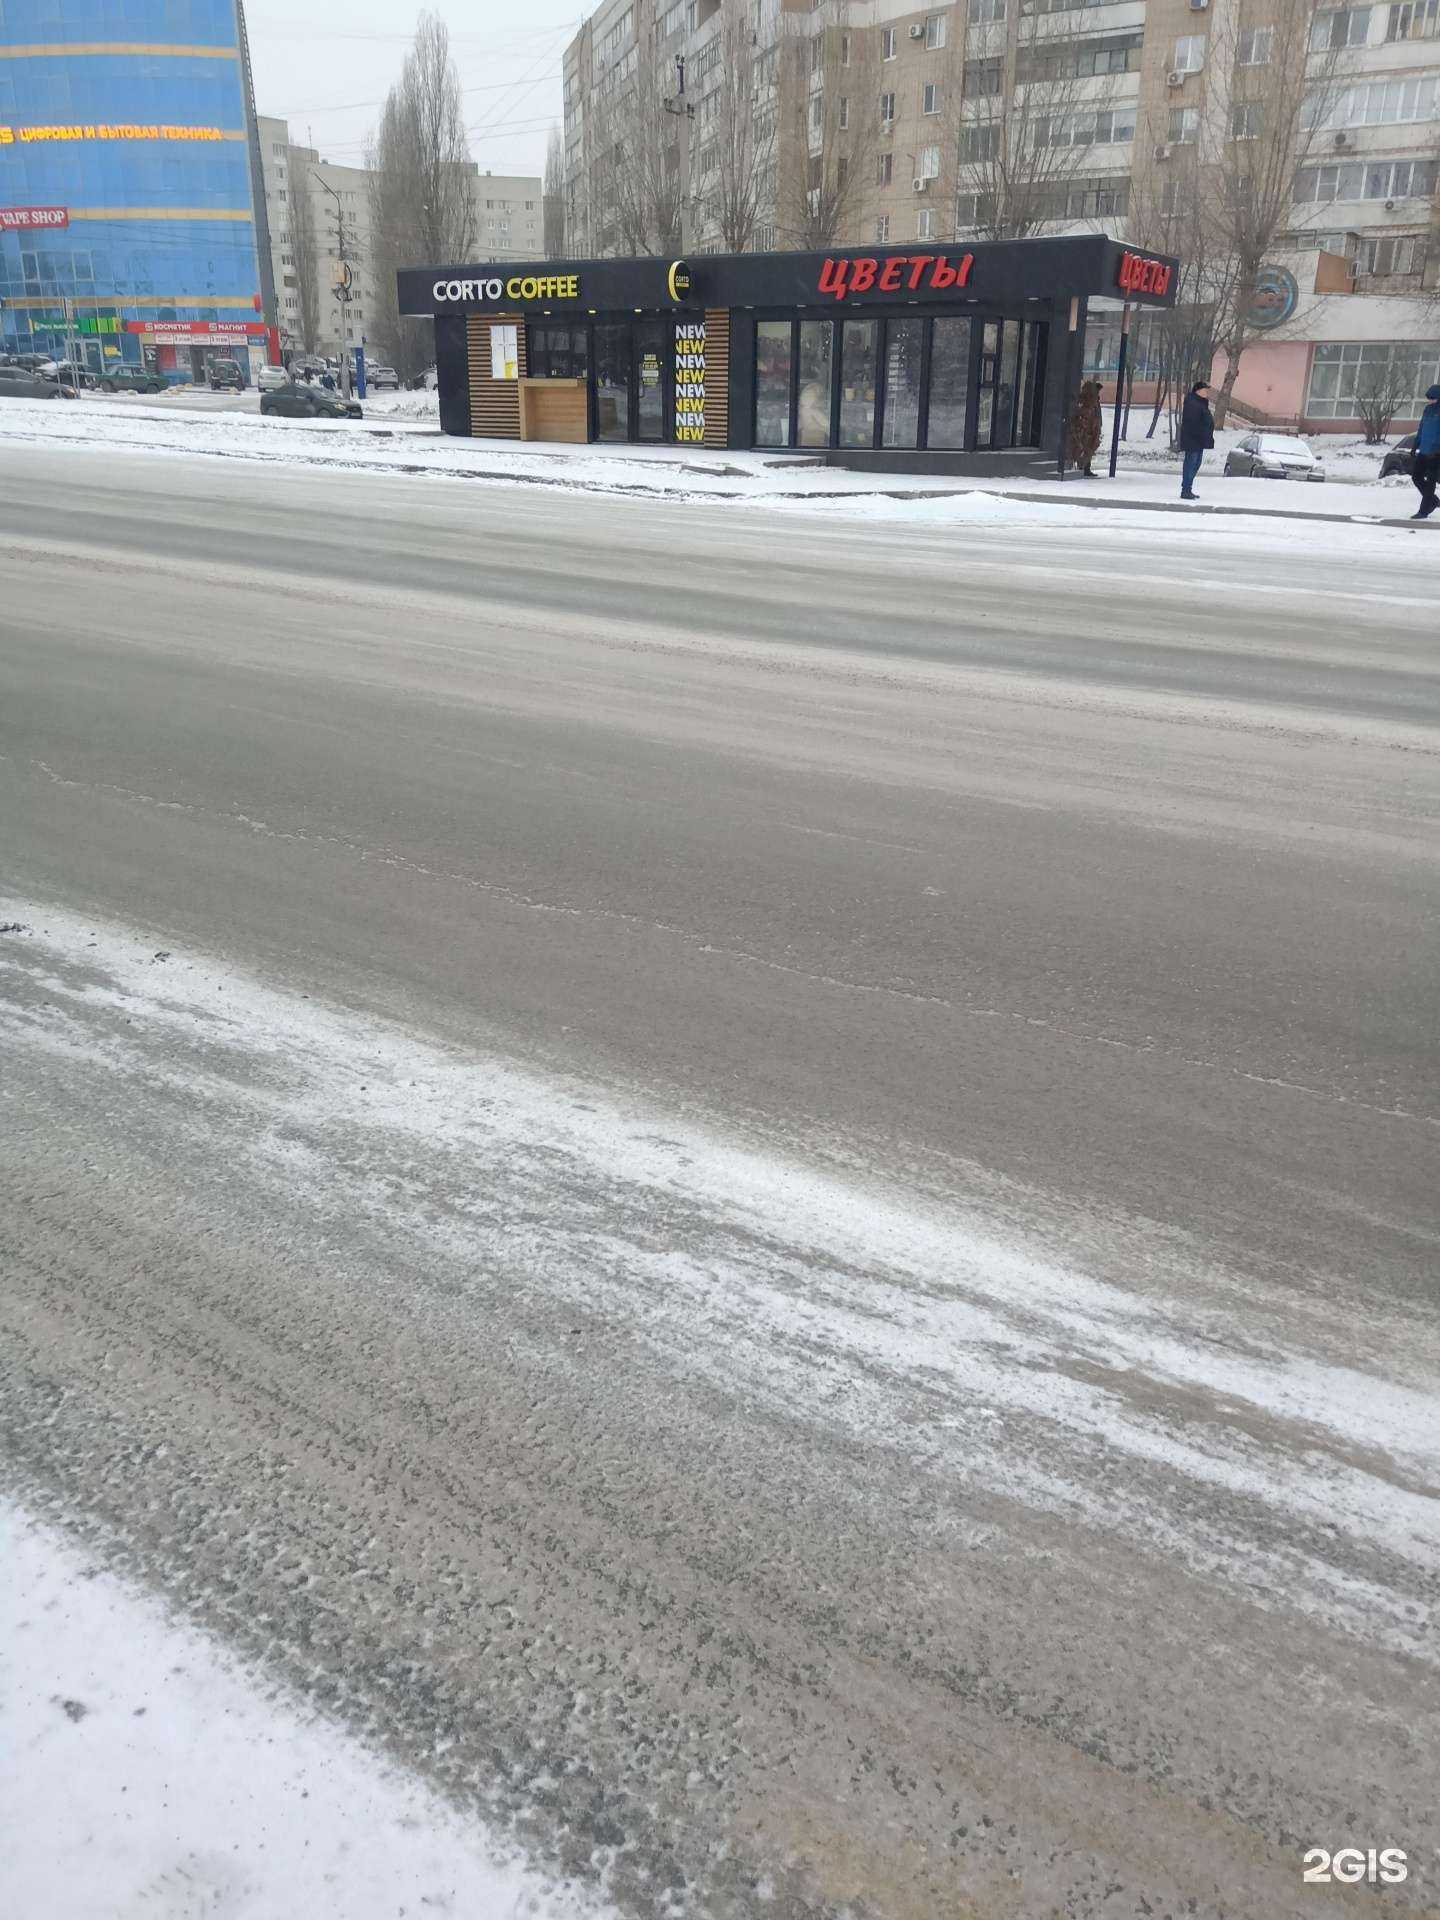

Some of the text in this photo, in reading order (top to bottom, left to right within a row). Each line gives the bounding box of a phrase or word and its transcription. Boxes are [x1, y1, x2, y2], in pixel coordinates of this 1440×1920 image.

[19, 125, 222, 142] ЦИФРОВАЯ И БЫТОВАЯ ТЕХНИКА
[1, 210, 65, 225] VAPE SHOP
[816, 252, 975, 300] ЦВЕТЫ
[1119, 250, 1172, 296] ЦВЕТЫ
[432, 275, 579, 302] CORTO COFFEE
[218, 324, 247, 332] МАГНИТ
